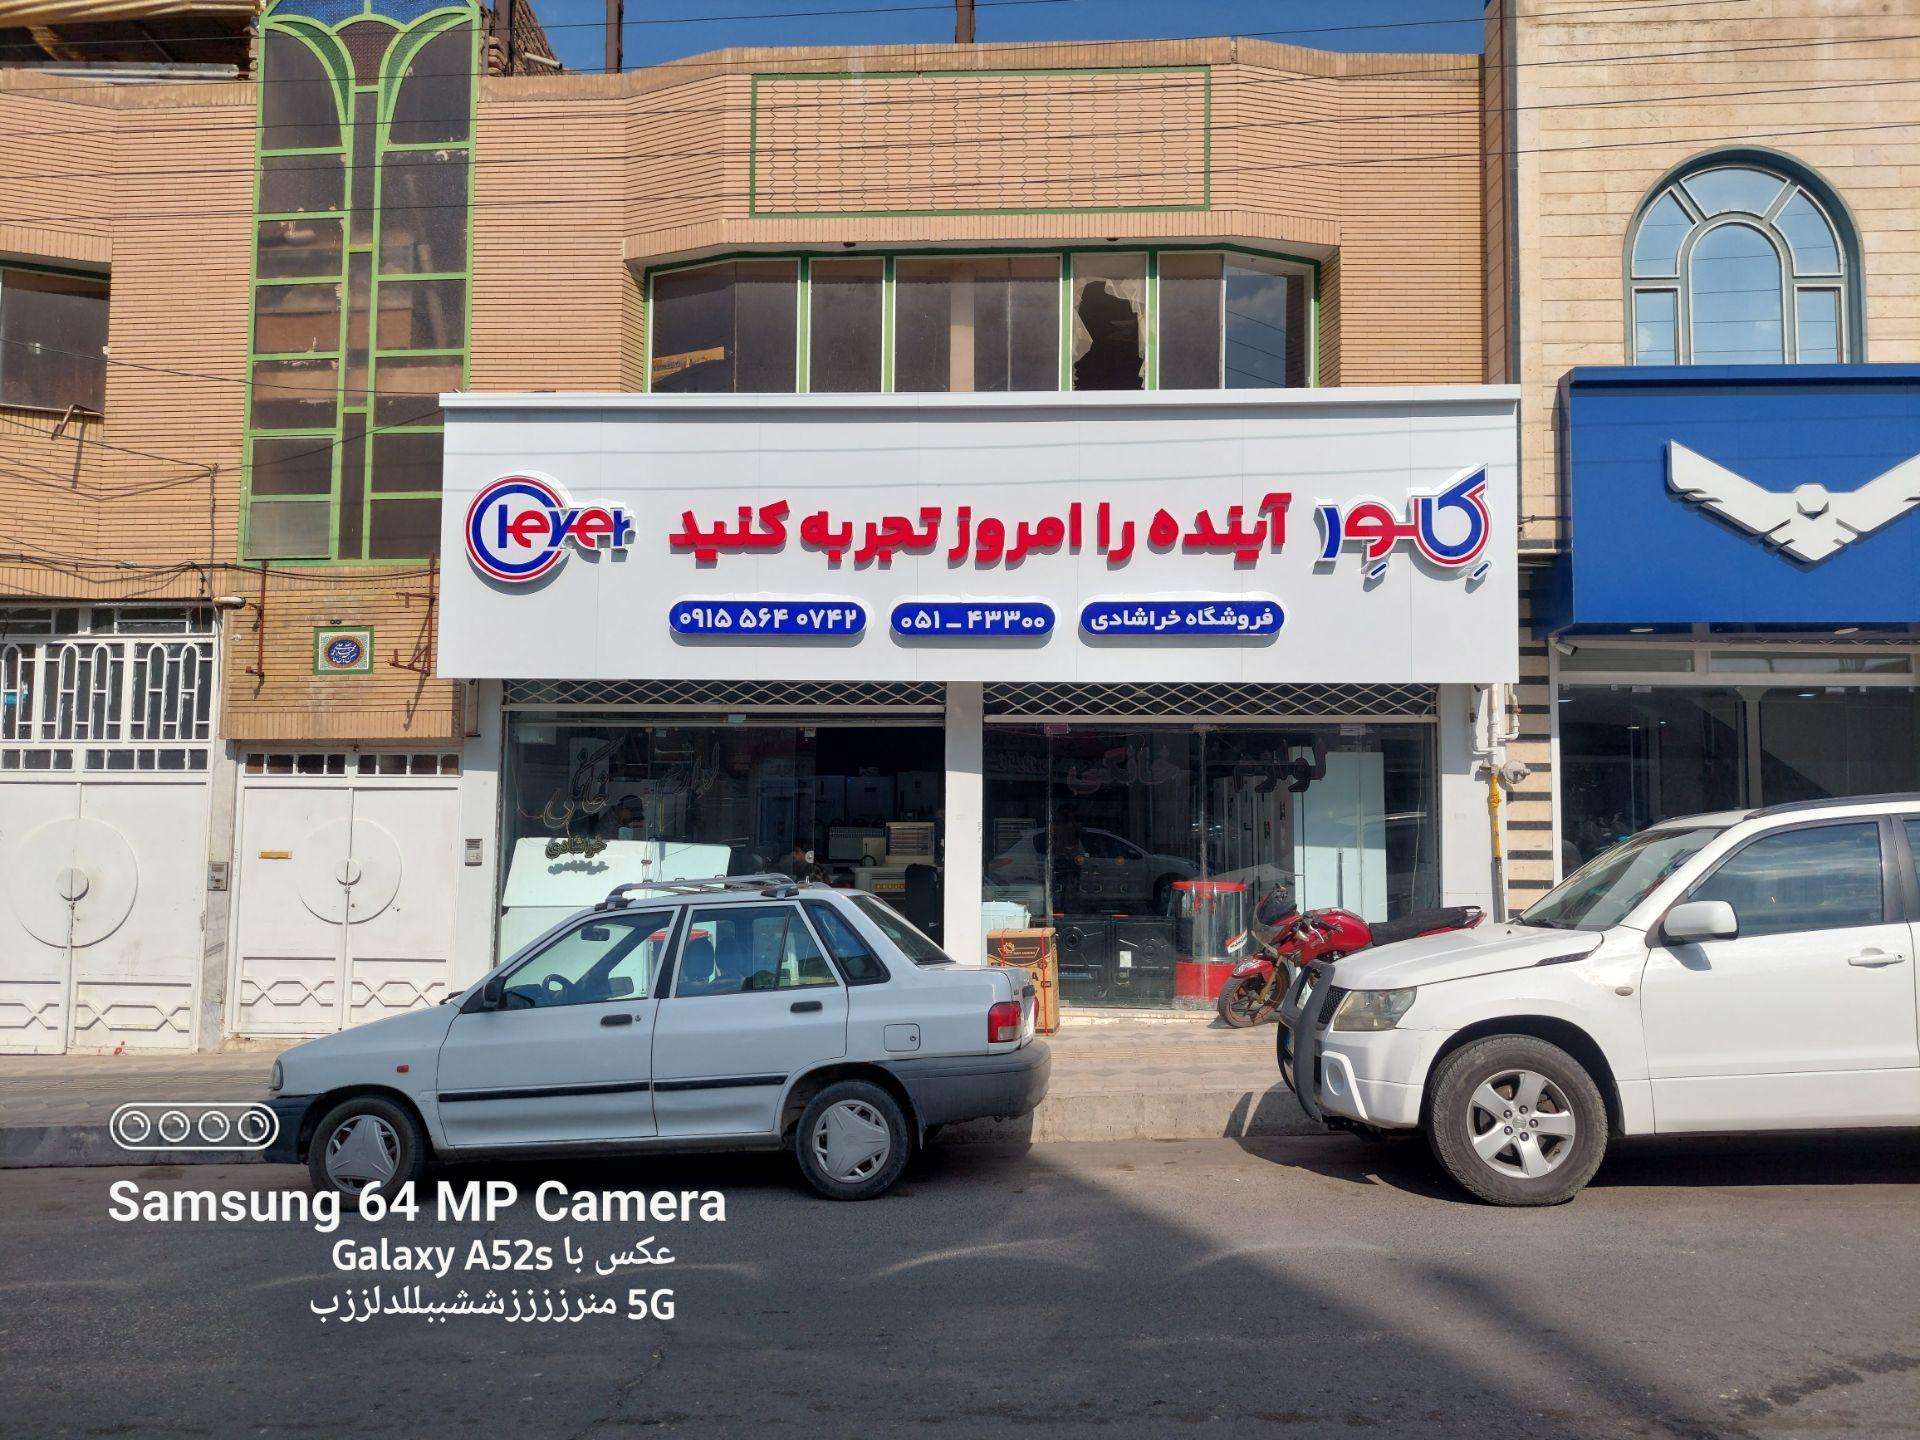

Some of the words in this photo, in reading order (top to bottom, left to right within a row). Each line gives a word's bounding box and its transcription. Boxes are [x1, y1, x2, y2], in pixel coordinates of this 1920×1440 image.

[465, 477, 631, 580] Clever
[669, 500, 790, 560] کنید
[800, 506, 942, 562] تجربه
[948, 502, 1082, 562] امروز
[1097, 502, 1135, 562] را
[1149, 492, 1291, 561] آینده
[680, 608, 733, 628] ۰۹۱۵
[739, 608, 789, 629] ۵۶۴
[796, 609, 857, 629] ۰۷۴۲
[1091, 607, 1181, 631] خراشادی
[1185, 606, 1274, 631] فروشگاه
